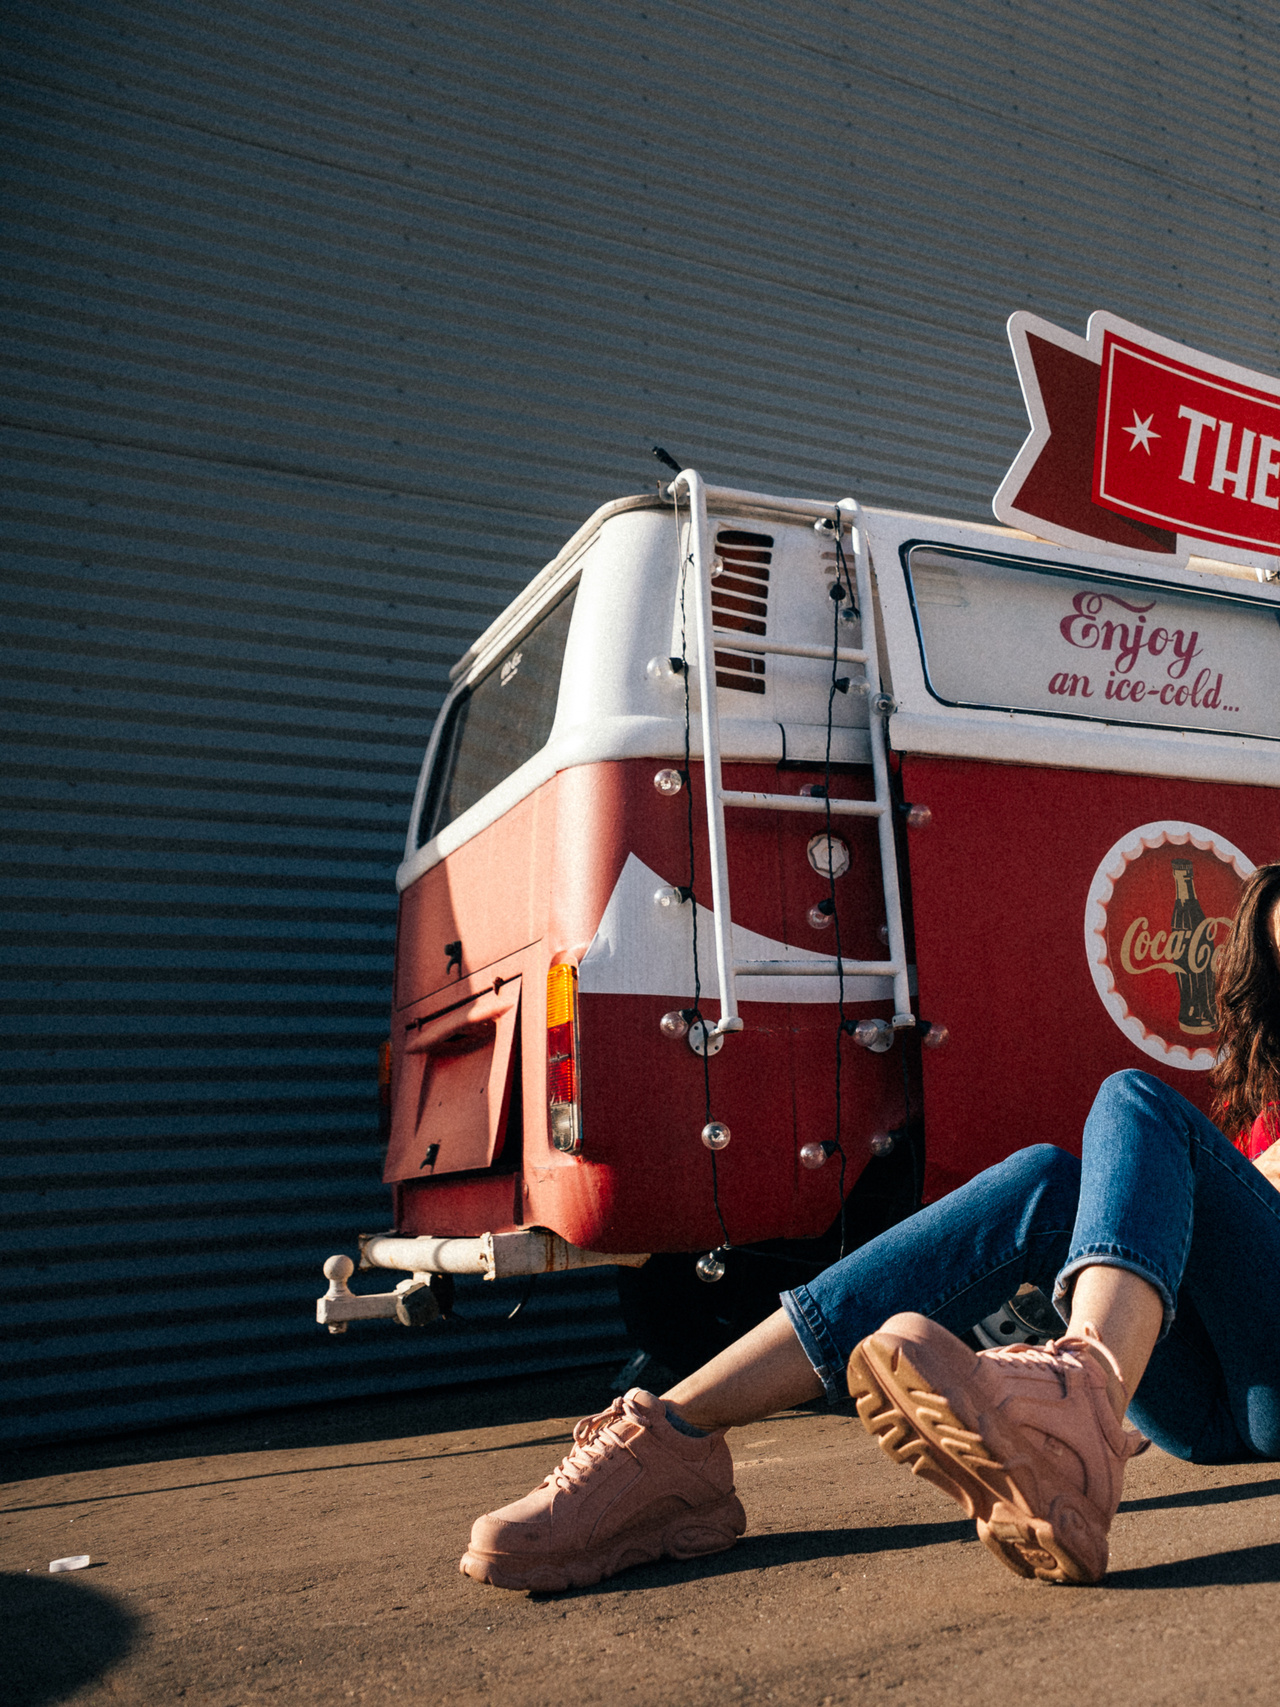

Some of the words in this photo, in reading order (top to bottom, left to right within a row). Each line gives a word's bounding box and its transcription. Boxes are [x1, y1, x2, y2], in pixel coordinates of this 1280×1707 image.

[1059, 591, 1203, 680] Enjoy
[1048, 672, 1094, 698] an
[1105, 668, 1240, 712] ice-cold...
